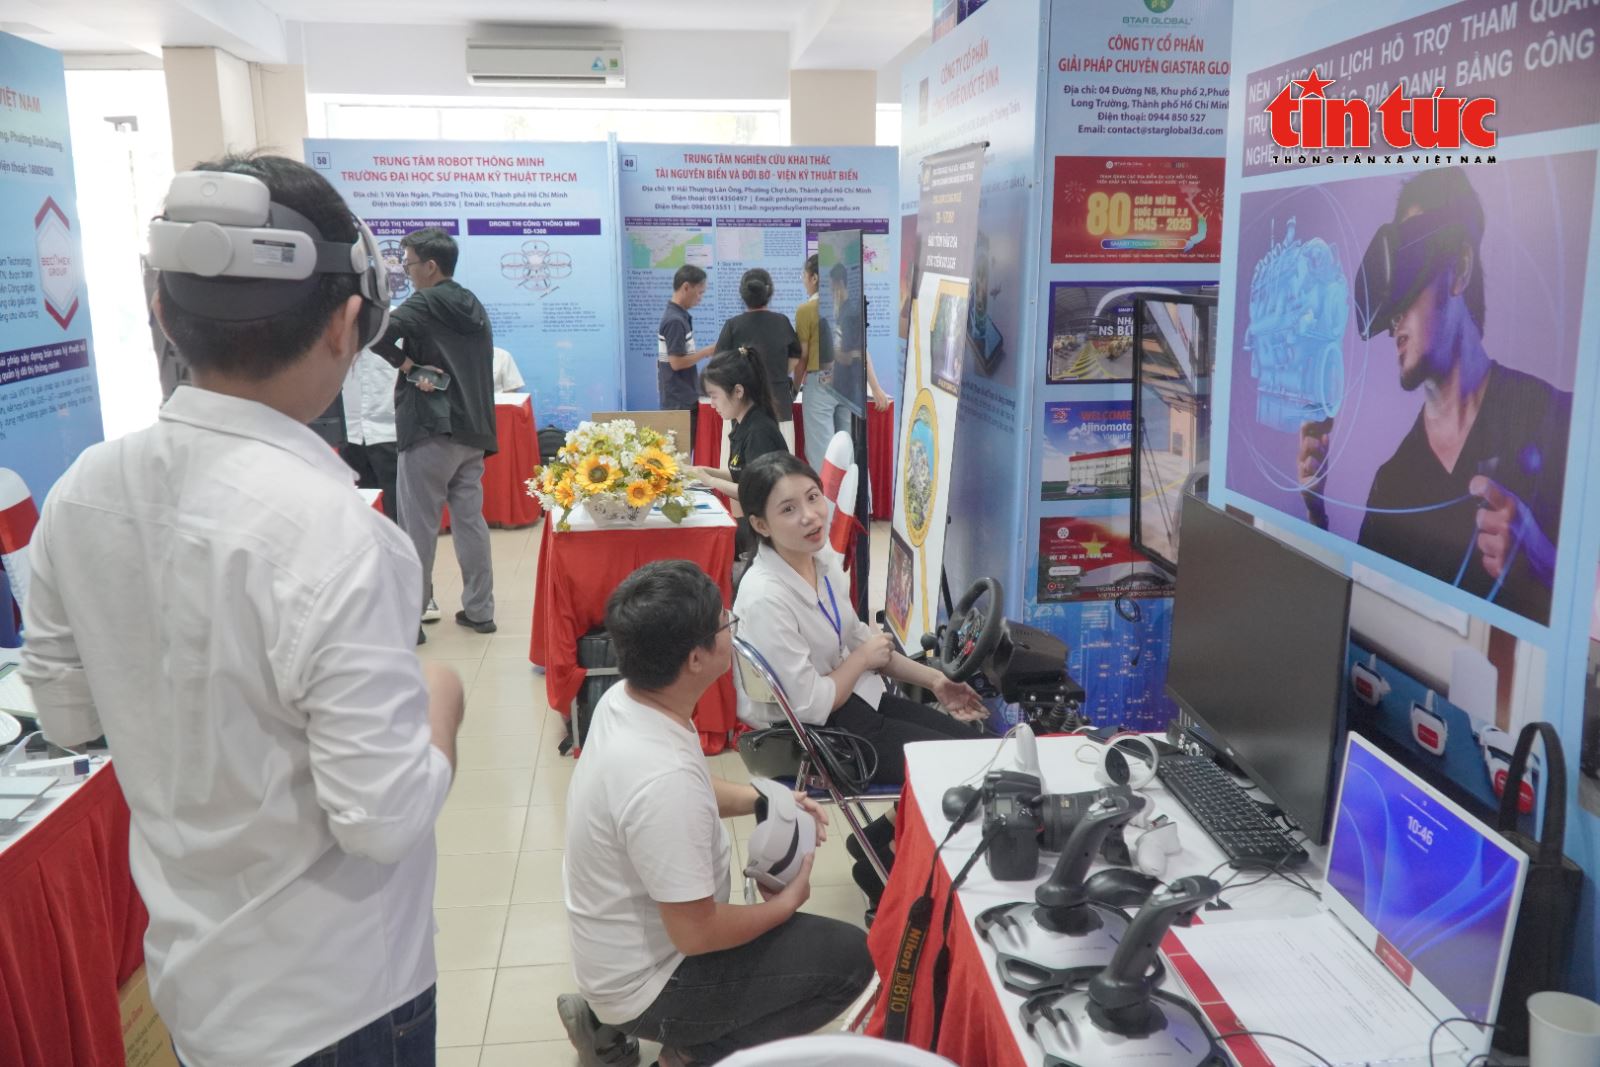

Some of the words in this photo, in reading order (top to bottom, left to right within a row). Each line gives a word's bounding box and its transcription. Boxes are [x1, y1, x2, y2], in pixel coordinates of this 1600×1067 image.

[1151, 16, 1191, 25] GLOBAL
[1108, 34, 1139, 51] CÔNG
[1141, 37, 1155, 51] TY
[1156, 33, 1172, 51] CỔ
[1173, 34, 1204, 52] PHẦN
[1340, 47, 1373, 80] LỊCH
[1381, 33, 1404, 66] HỖ
[1413, 23, 1452, 56] TRỢ
[1460, 2, 1518, 42] THAM
[1058, 54, 1081, 72] GIẢI
[1083, 56, 1113, 72] PHÁP
[1115, 57, 1159, 74] CHUYÊN
[1160, 59, 1206, 75] GIASTAR
[1456, 49, 1513, 87] BẰNG
[1524, 28, 1595, 71] CÔNG
[1063, 85, 1079, 96] Địa
[1081, 84, 1098, 95] chỉ:
[1098, 86, 1110, 95] 04
[1111, 85, 1142, 97] Đường
[1160, 87, 1178, 96] Khu
[1180, 86, 1198, 98] phố
[1071, 99, 1094, 110] Long
[1095, 99, 1130, 110] Trường,
[1132, 99, 1159, 109] Thành
[1161, 99, 1179, 111] phố
[1180, 99, 1193, 109] Hồ
[1194, 99, 1209, 109] Chí
[1097, 112, 1118, 123] Điện
[1120, 112, 1146, 124] thoại:
[1148, 113, 1170, 122] 0944
[1171, 114, 1188, 122] 850
[1189, 114, 1206, 123] 527
[1077, 125, 1106, 134] Email:
[1107, 126, 1224, 136] contact@starglobal3d.com
[372, 156, 411, 167] TRUNG
[412, 154, 436, 167] TÂM
[437, 156, 474, 167] ROBOT
[475, 154, 514, 167] THÔNG
[516, 157, 545, 167] MINH
[683, 153, 713, 164] TRUNG
[714, 152, 733, 164] TÂM
[734, 153, 767, 165] NGHIÊN
[768, 153, 786, 165] CỨU
[787, 155, 808, 165] KHAI
[809, 154, 831, 165] THÁC
[341, 169, 387, 182] TRƯỜNG
[390, 171, 409, 184] ĐẠI
[411, 171, 435, 184] HỌC
[436, 171, 451, 182] SƯ
[453, 171, 485, 184] PHẠM
[488, 170, 501, 182] KỸ
[503, 171, 536, 184] THUẬT
[538, 172, 577, 182] TP.HCM
[655, 167, 669, 179] TÀI
[670, 167, 705, 179] NGUYÊN
[707, 166, 727, 179] BIỂN
[728, 168, 740, 179] VÀ
[776, 169, 796, 182] VIỆN
[798, 169, 809, 180] KỸ
[810, 170, 837, 182] THUẬT
[838, 168, 858, 180] BIỂN
[1086, 191, 1132, 237] 80
[1134, 218, 1158, 231] 1945
[1166, 217, 1192, 231] 2025
[1098, 325, 1114, 336] NS
[1080, 422, 1132, 433] Ajinomoto
[1408, 815, 1434, 846] 10:46
[901, 927, 922, 970] Nikon
